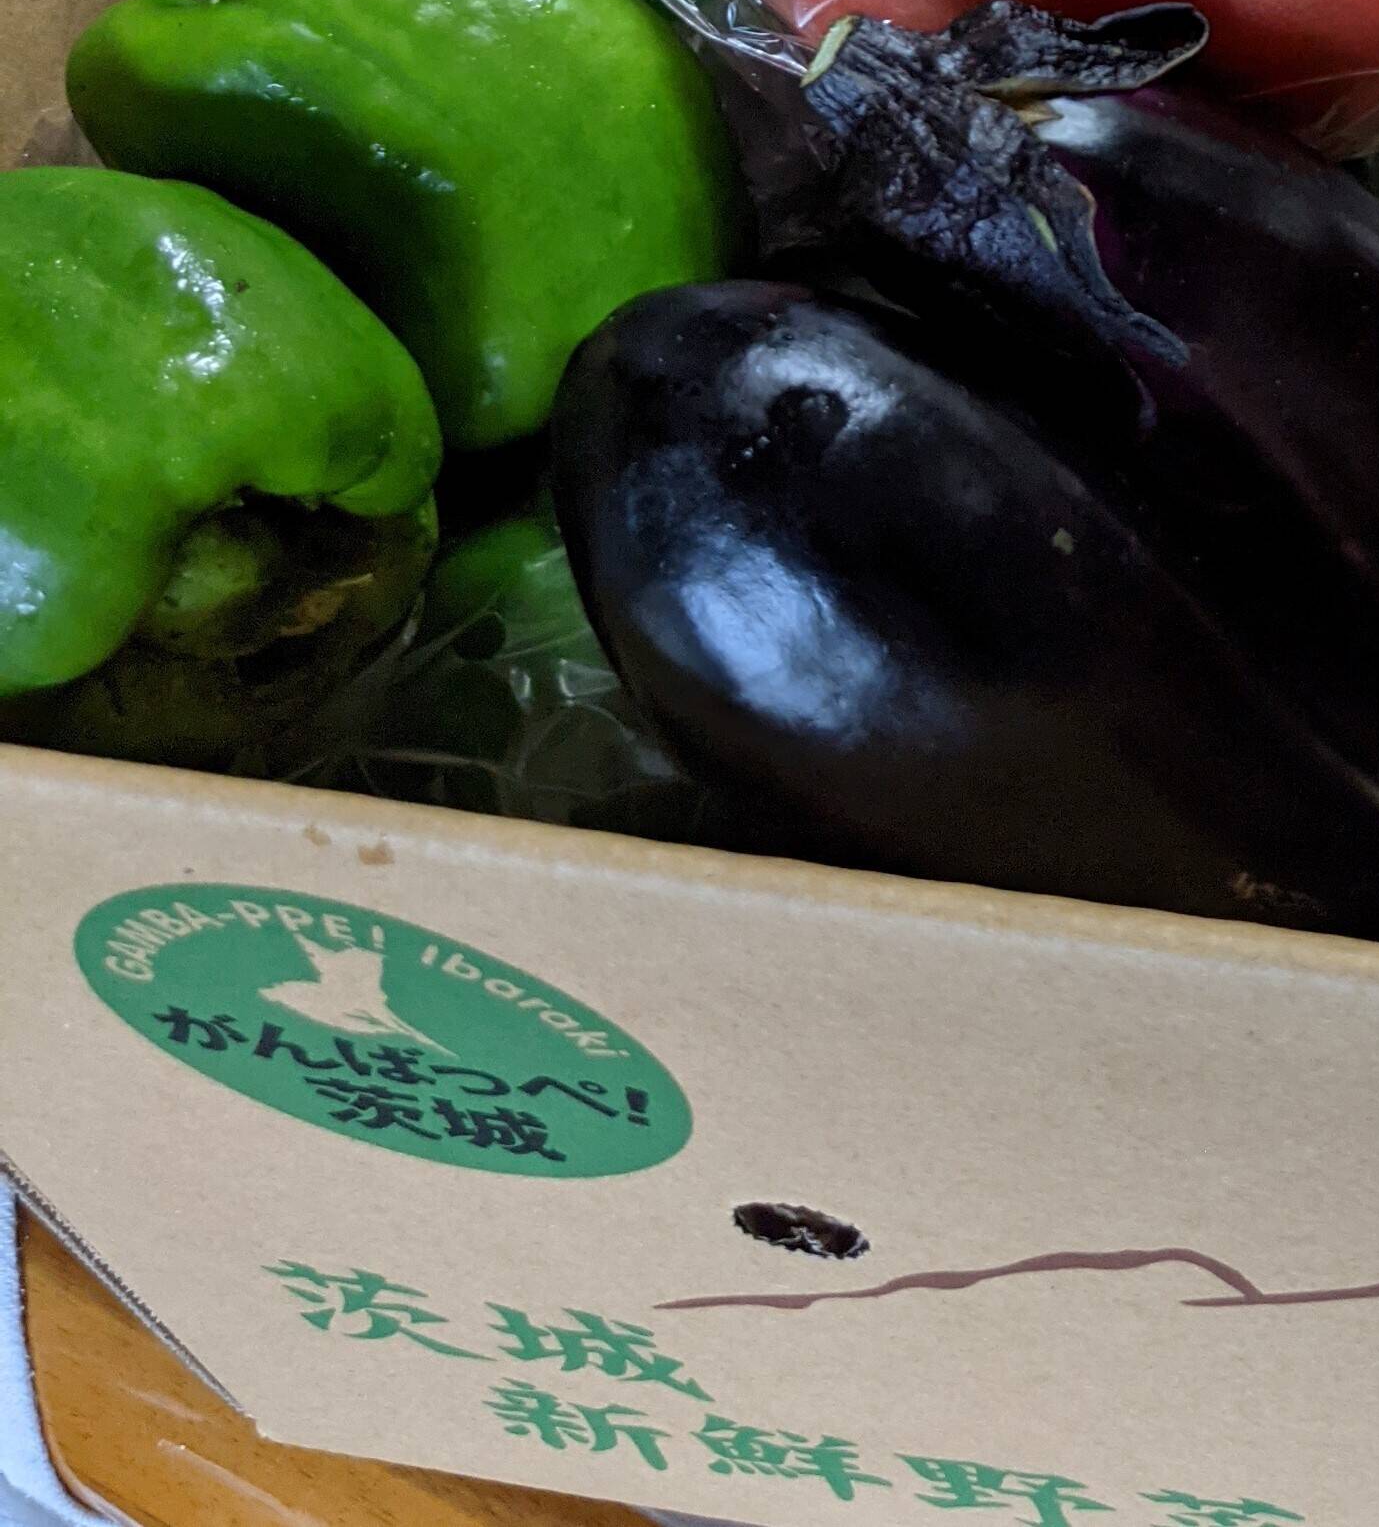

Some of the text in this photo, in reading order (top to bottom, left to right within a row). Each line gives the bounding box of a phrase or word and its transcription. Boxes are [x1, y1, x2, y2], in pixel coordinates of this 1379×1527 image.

[420, 944, 631, 1057] Ibaraki
[303, 1075, 567, 1163] 茨城
[260, 1259, 716, 1403] 茨城
